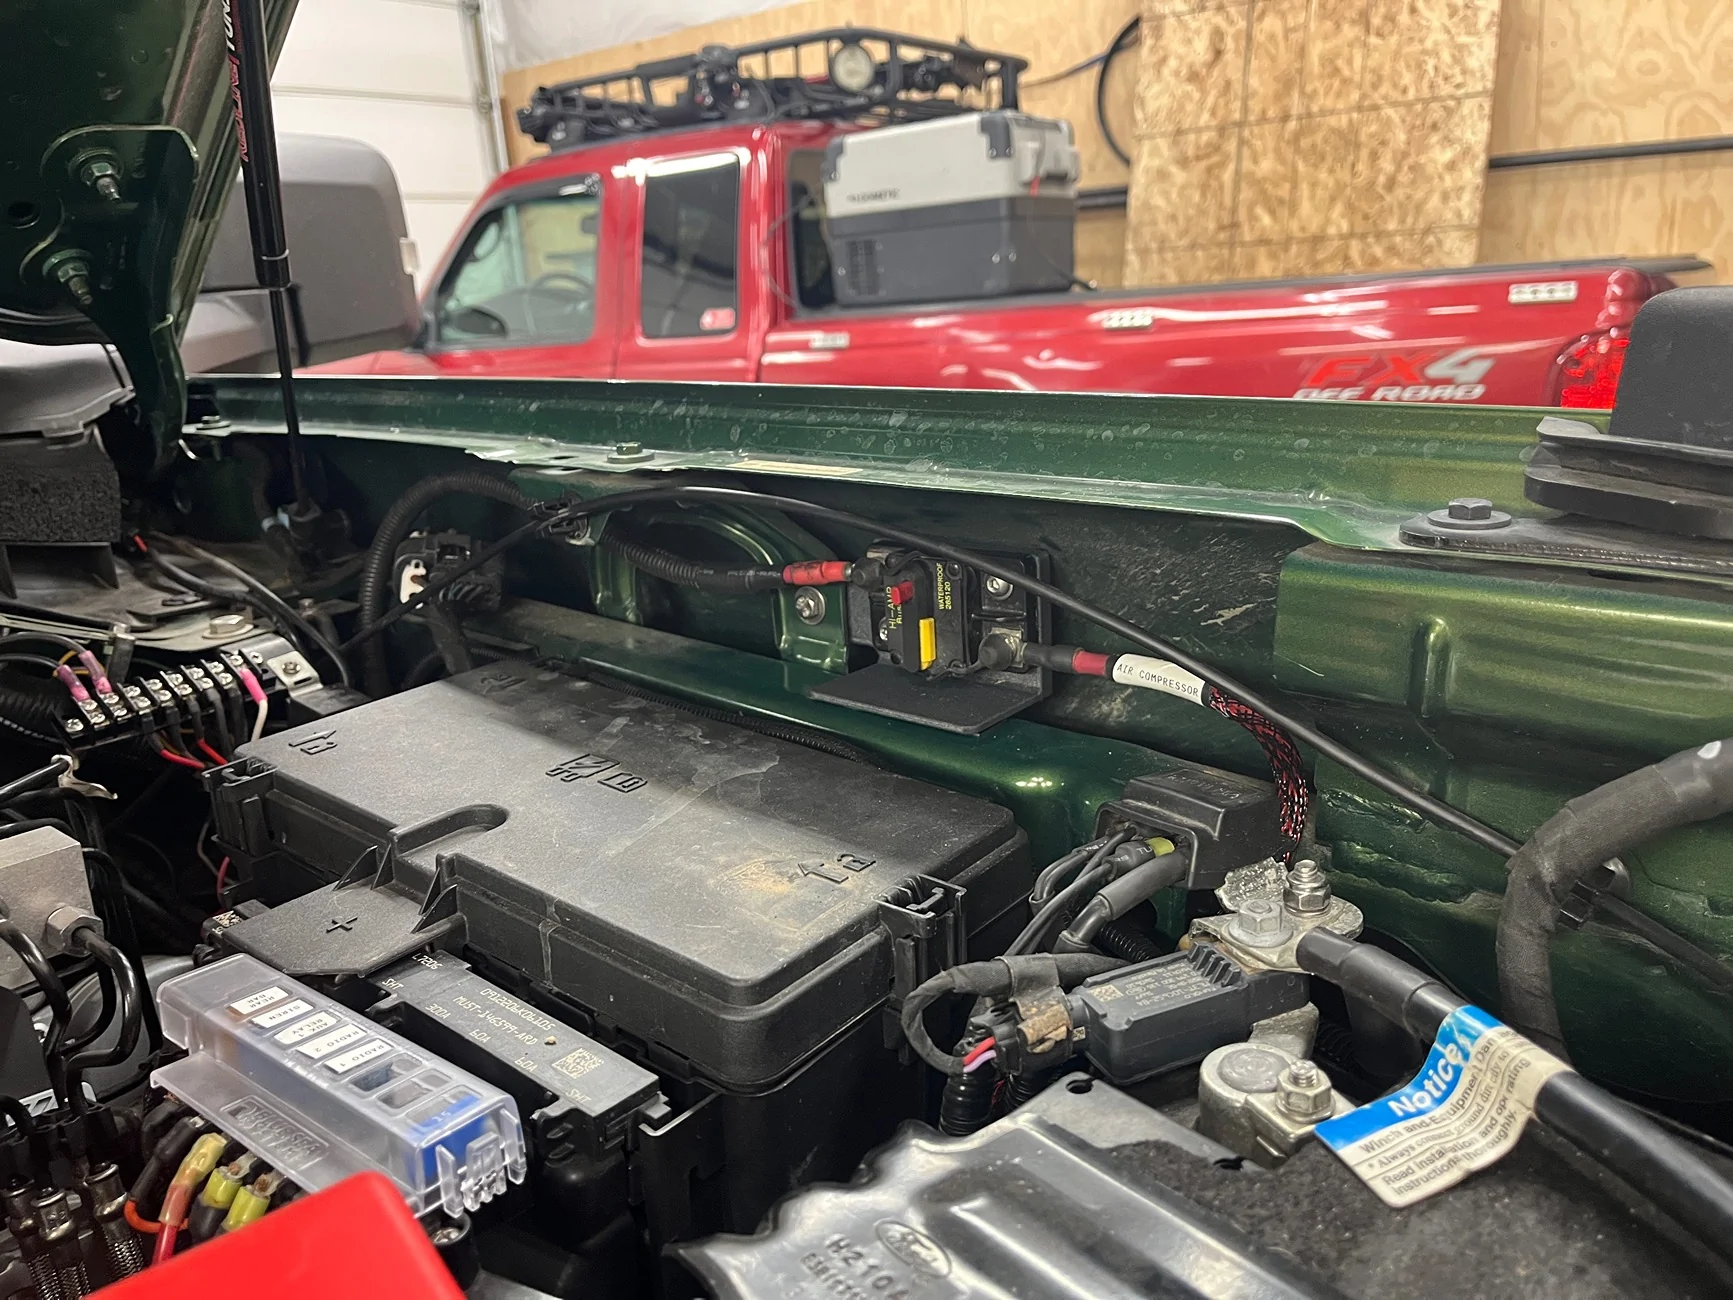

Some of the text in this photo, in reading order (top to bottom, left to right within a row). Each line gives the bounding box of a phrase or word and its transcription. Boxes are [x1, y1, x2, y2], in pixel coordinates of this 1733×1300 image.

[1306, 348, 1495, 386] FX4
[1293, 384, 1486, 401] OFF ROAD
[936, 562, 945, 610] WATERPROOF
[1117, 663, 1199, 697] AIR COMPRESSOR
[248, 994, 266, 1003] BAR
[250, 996, 275, 1009] REAR
[268, 1004, 301, 1021] SIREN
[292, 1018, 324, 1036] RELAY
[311, 1021, 329, 1033] AUX
[327, 1030, 360, 1048] RADIO
[351, 1044, 385, 1062] RADIO
[1361, 1129, 1404, 1154] Winch
[1404, 1118, 1430, 1133] and
[1462, 1109, 1518, 1162] thoroughly.
[1378, 1143, 1416, 1168] Always
[1382, 1165, 1416, 1186] Read
[1480, 1115, 1498, 1138] and
